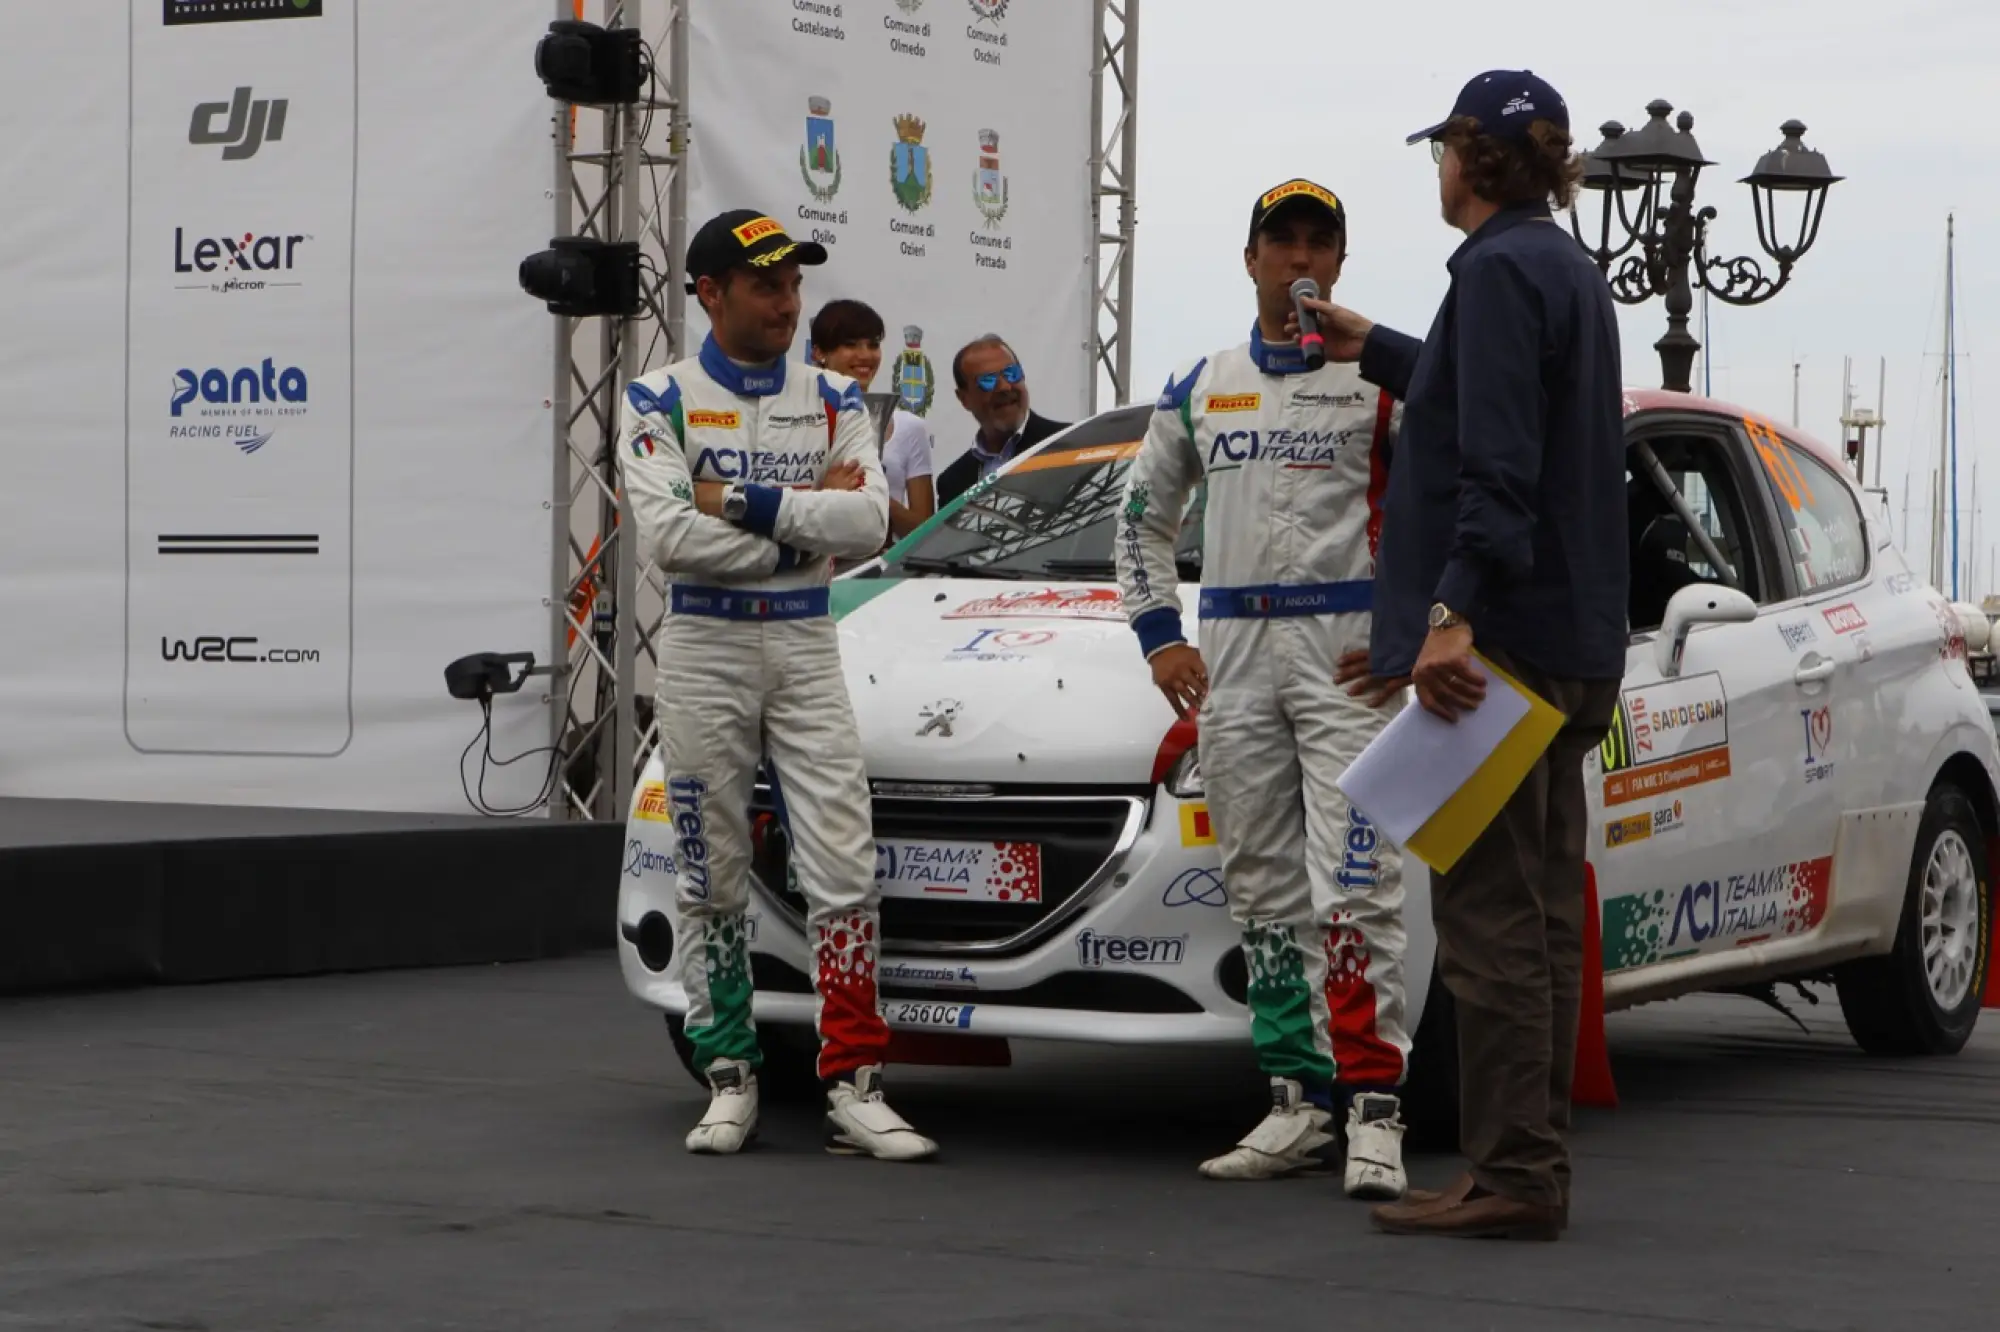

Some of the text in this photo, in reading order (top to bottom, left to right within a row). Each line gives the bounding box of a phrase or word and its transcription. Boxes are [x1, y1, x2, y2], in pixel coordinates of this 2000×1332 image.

[792, 0, 843, 18] Comune di
[791, 17, 845, 41] Castelsardo
[884, 15, 931, 38] Comune di
[966, 24, 1008, 47] Comune di
[890, 38, 926, 57] Olmedo
[973, 47, 1000, 66] Oschiri
[797, 205, 848, 225] Comune di
[812, 228, 837, 245] Osilo
[890, 218, 935, 238] Comune di
[174, 226, 305, 273] Lexar
[900, 241, 926, 257] Ozieri
[969, 230, 1012, 251] Comune di
[974, 252, 1007, 270] Pattada
[220, 278, 265, 293] Micron
[169, 357, 308, 417] panta
[200, 408, 237, 417] MEMBER
[169, 425, 260, 438] RACING FUEL
[1267, 430, 1335, 445] TEAM
[1208, 430, 1259, 464] ACI
[1259, 446, 1335, 462] ITALIA
[750, 451, 811, 466] TEAM
[749, 467, 814, 482] ITALIA
[1629, 697, 1654, 755] 2016
[1652, 699, 1724, 734] SARDEGNA
[1805, 763, 1835, 784] SPORT
[638, 788, 666, 814] PIRE
[1653, 806, 1673, 828] sara
[669, 777, 711, 900] freem
[1336, 806, 1378, 888] fre
[875, 845, 898, 880] CI
[904, 845, 966, 864] TEAM
[898, 865, 970, 883] ITALIA
[1725, 868, 1776, 903] TEAM
[1667, 880, 1720, 947] ACI
[1718, 900, 1778, 937] ITALIA
[1078, 929, 1183, 967] freem
